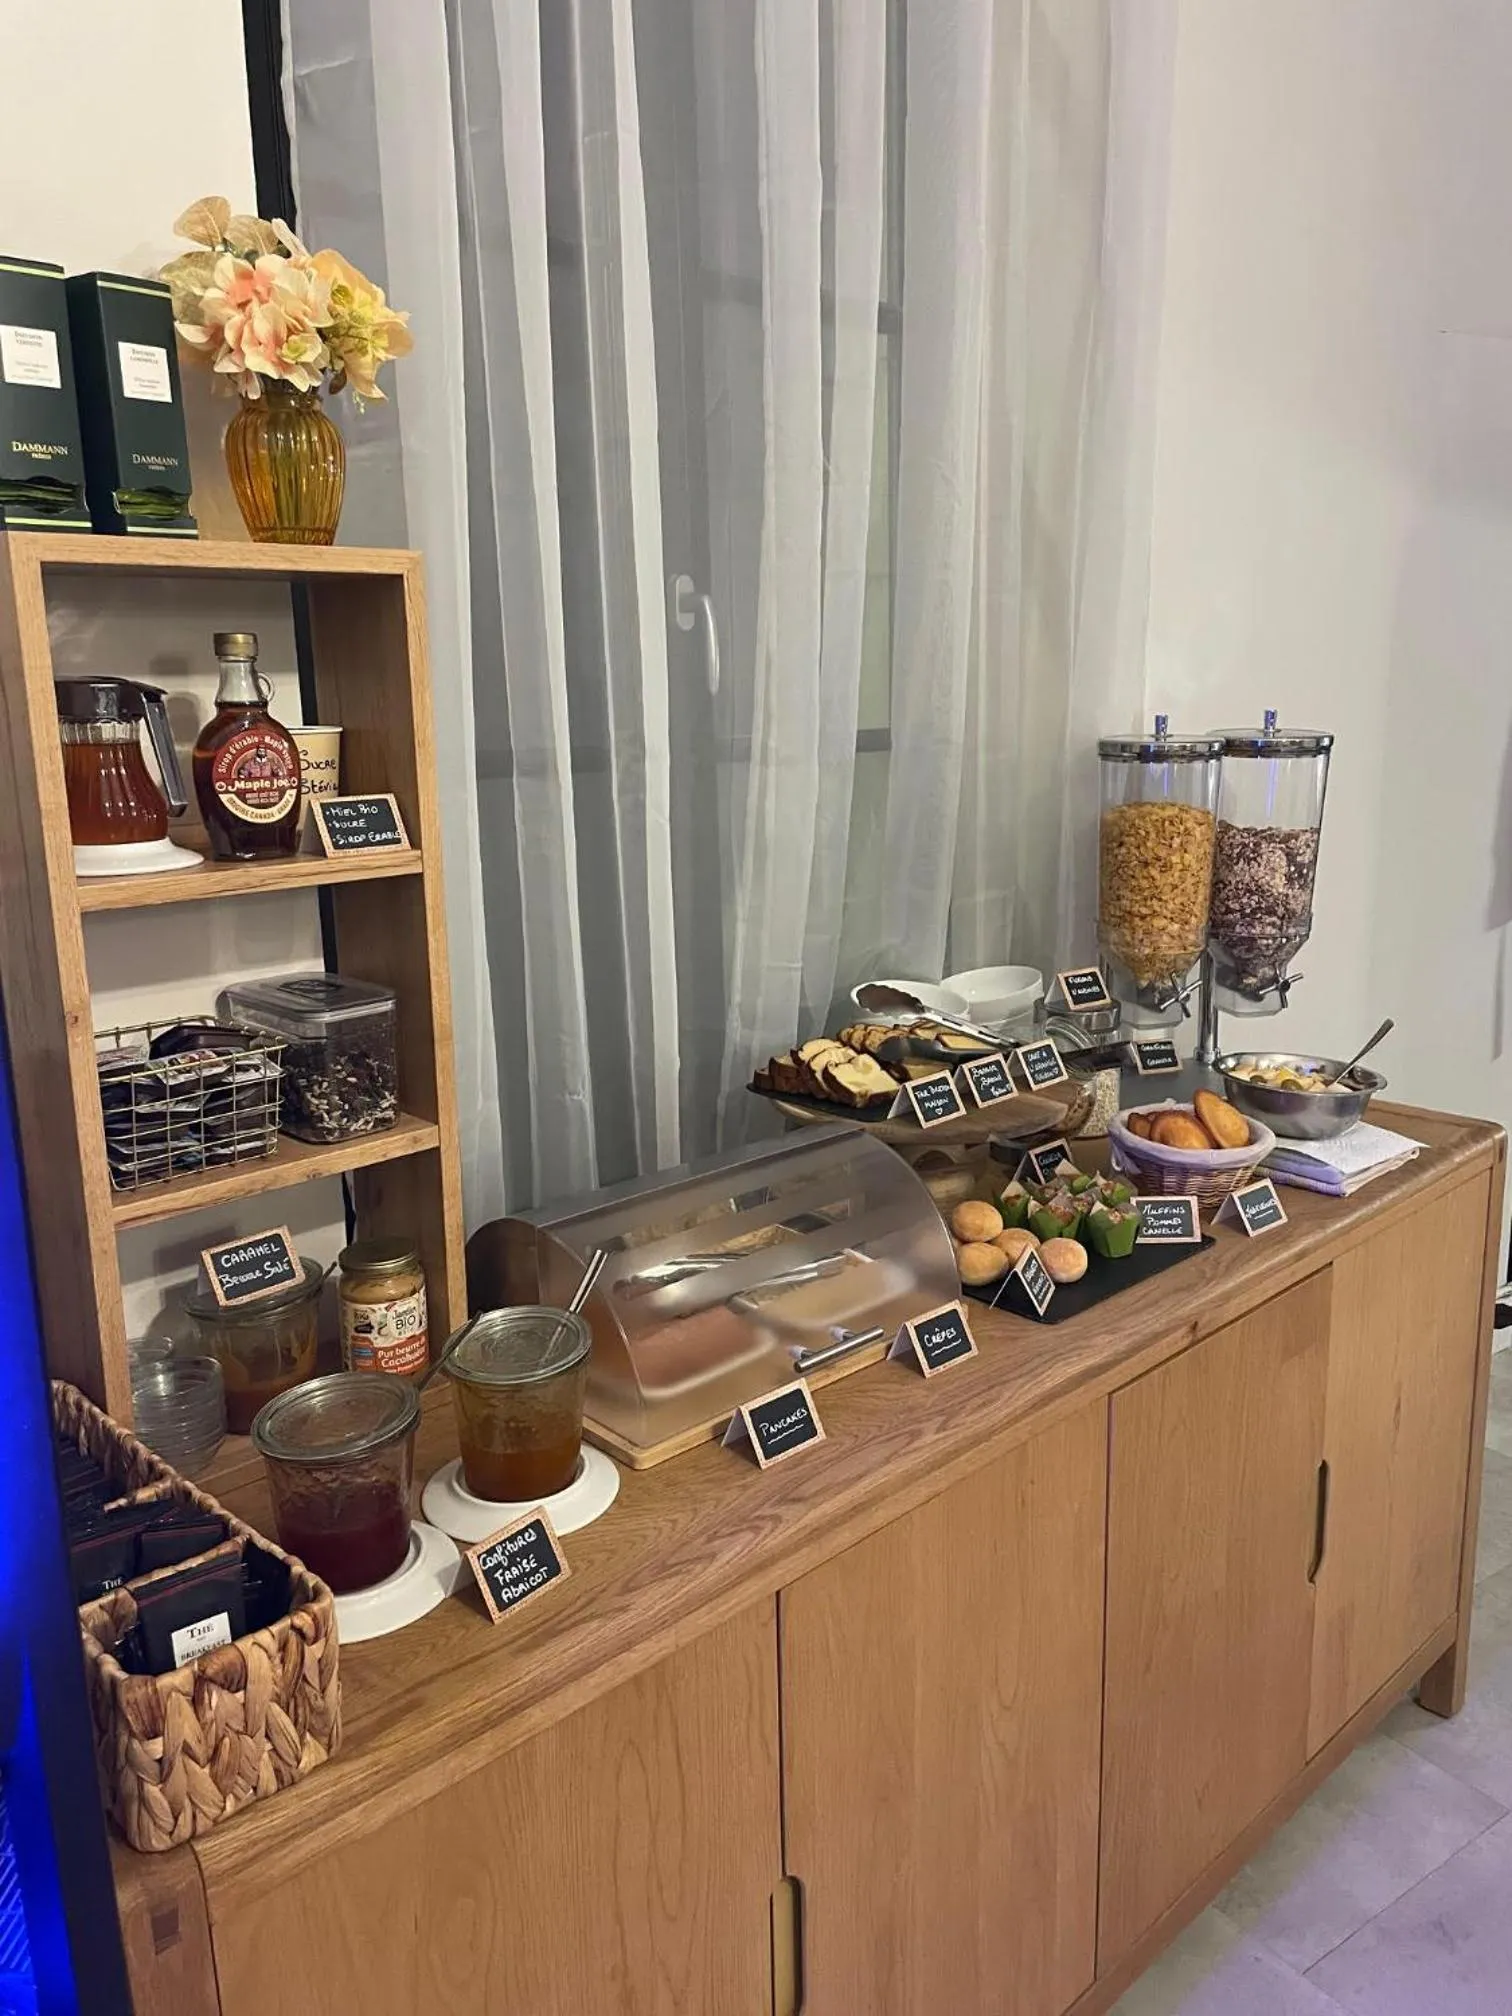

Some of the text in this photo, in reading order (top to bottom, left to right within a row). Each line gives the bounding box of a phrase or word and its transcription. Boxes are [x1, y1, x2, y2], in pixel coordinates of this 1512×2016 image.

[11, 441, 68, 455] DAMMANN
[132, 454, 178, 467] DAMMANN
[218, 752, 232, 774] Sirop
[227, 778, 271, 791] Maple
[221, 1242, 280, 1268] CARAMEL
[396, 1314, 416, 1330] BIO
[377, 1349, 394, 1359] Pur
